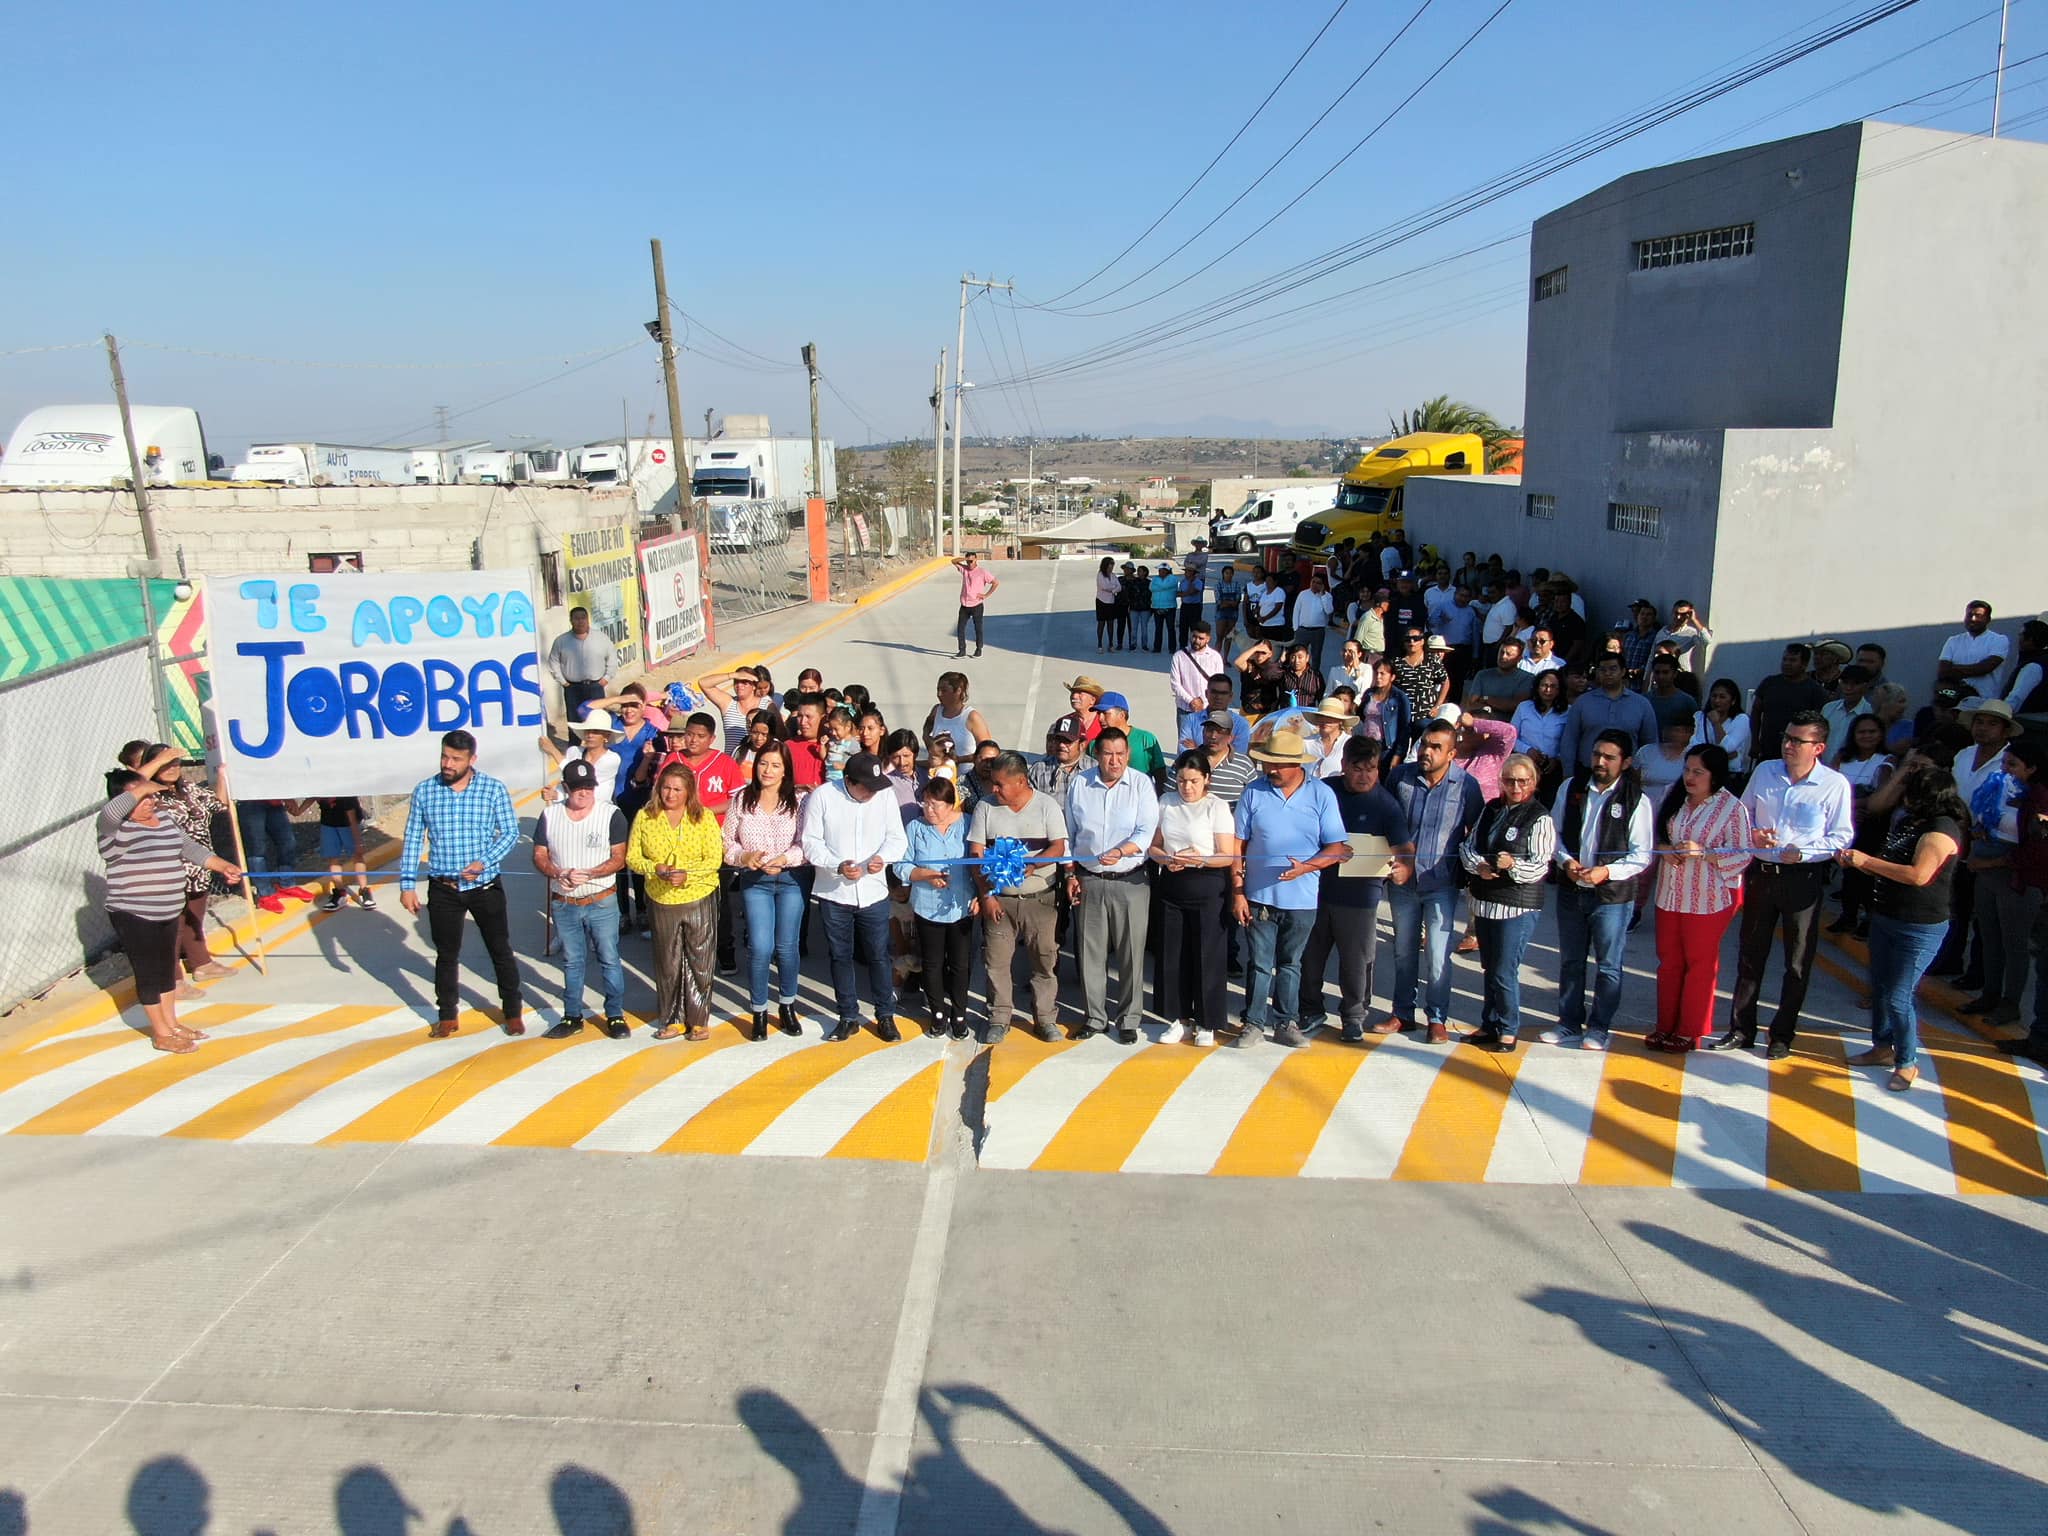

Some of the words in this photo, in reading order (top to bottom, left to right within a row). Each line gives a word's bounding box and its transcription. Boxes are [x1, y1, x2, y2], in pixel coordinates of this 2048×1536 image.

[22, 440, 112, 453] LOGISTICS
[327, 452, 349, 466] AUTO
[570, 531, 600, 558] FAVOR
[600, 529, 613, 552] DE
[613, 526, 625, 549] NO
[569, 556, 634, 592] ESTACIONARSE
[647, 550, 660, 574] NO
[240, 580, 328, 633] TE
[352, 590, 537, 648] APOYA
[656, 614, 679, 641] VUELTA
[617, 618, 630, 642] DE
[228, 641, 545, 759] JOROBAS
